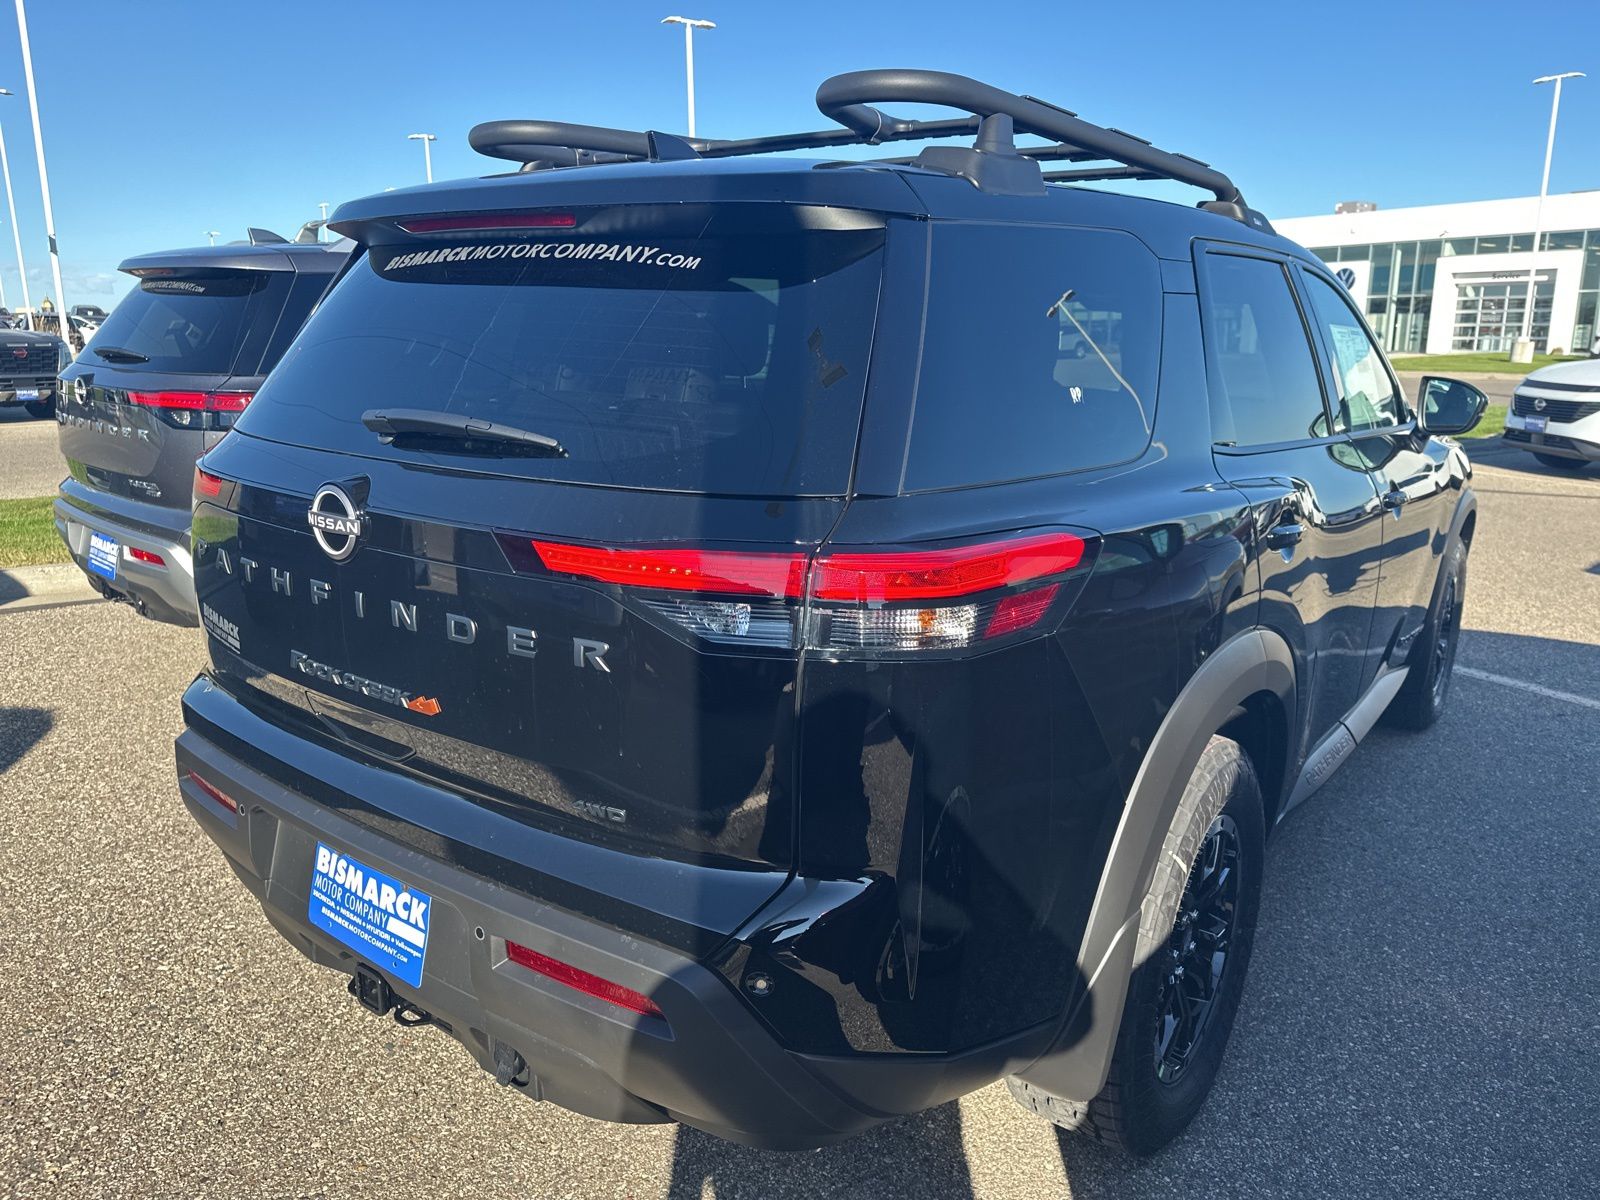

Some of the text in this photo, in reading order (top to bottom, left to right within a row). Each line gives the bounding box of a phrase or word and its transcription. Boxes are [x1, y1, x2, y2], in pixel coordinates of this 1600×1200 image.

[1491, 271, 1521, 279] Service
[308, 511, 358, 534] NISSAN
[203, 602, 240, 641] BISMARCK
[314, 873, 388, 928] MOTOR COMPANY
[317, 846, 427, 930] BISMARCK
